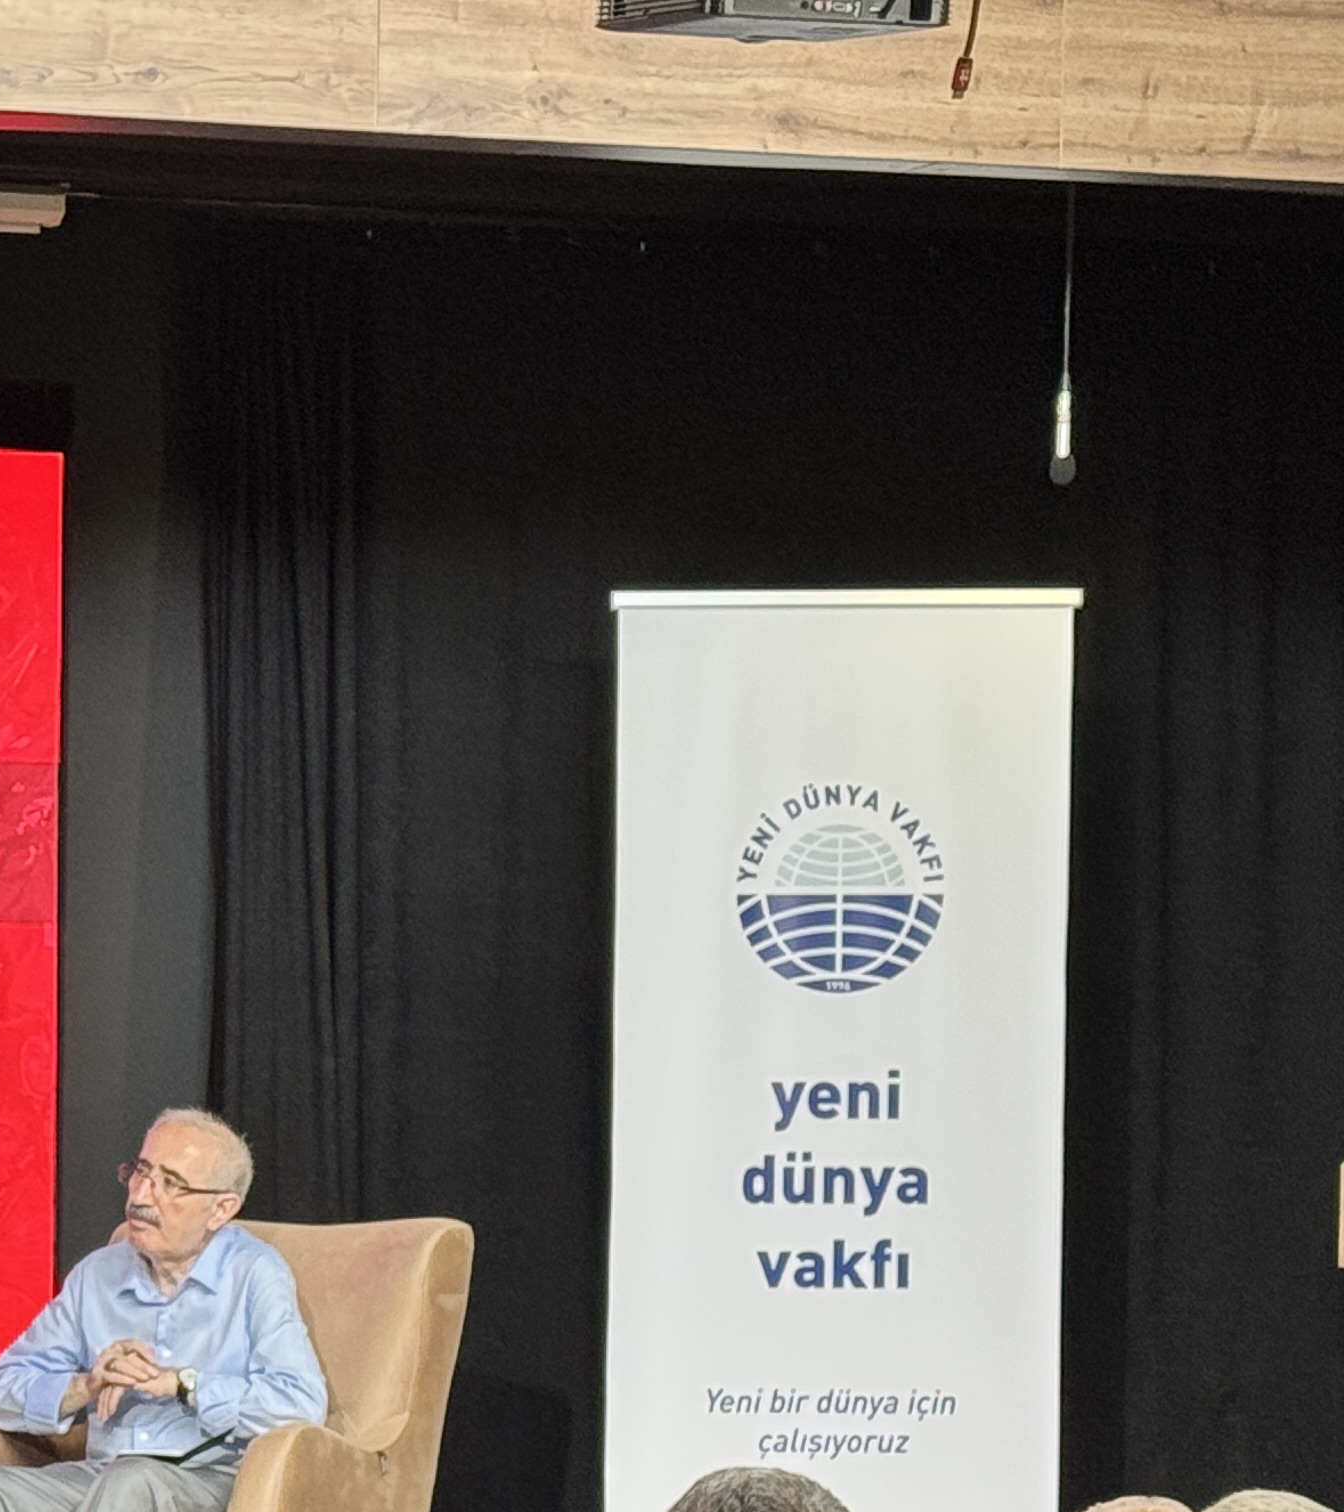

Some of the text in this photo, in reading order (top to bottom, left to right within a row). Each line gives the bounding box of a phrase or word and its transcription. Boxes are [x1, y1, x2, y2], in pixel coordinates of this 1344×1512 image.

[736, 783, 944, 883] YENİ DÜNYA VAKFI
[771, 1069, 900, 1132] yeni
[743, 1151, 929, 1217] dünya
[757, 1239, 909, 1289] vakfı
[707, 1388, 956, 1422] Yeni bir dünya için
[759, 1427, 910, 1460] çalışıyoruz
